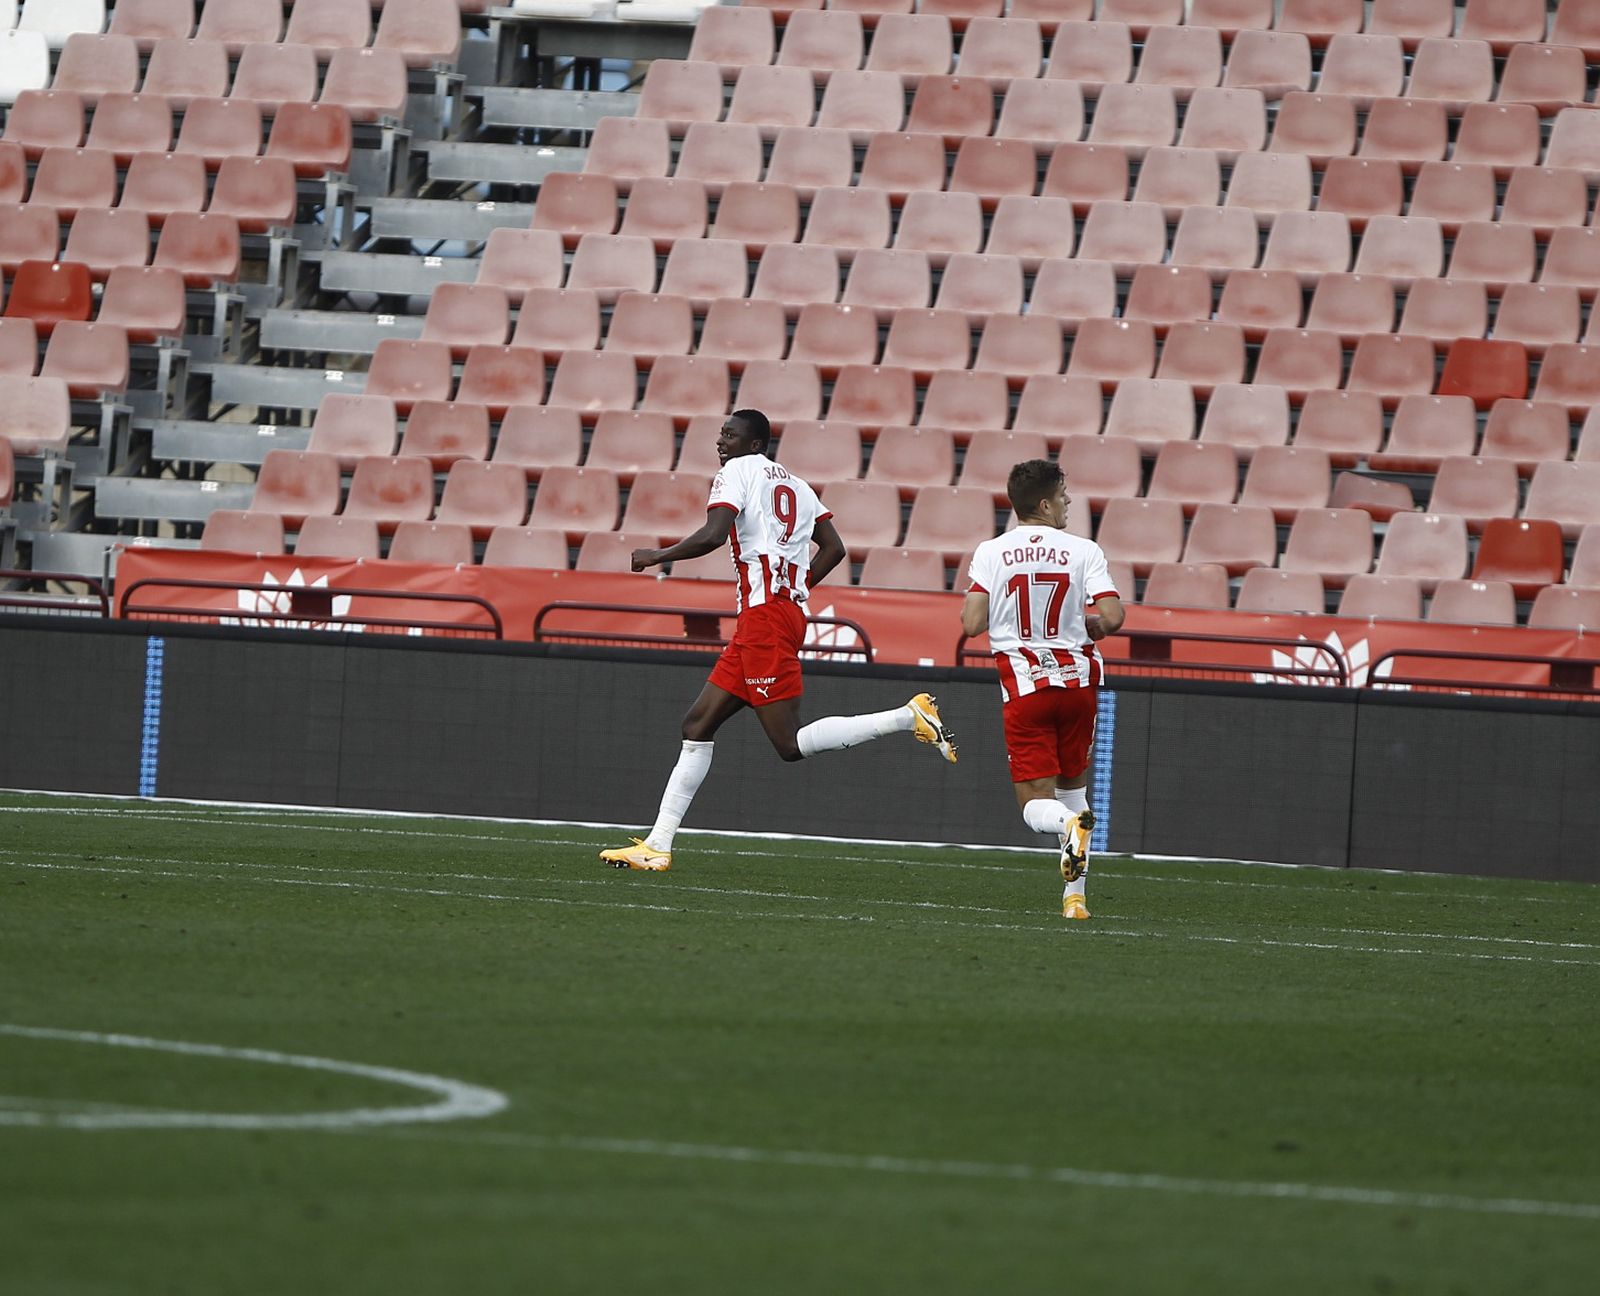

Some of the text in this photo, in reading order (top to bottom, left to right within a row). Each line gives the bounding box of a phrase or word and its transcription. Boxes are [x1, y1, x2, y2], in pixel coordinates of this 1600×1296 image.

[772, 484, 797, 545] 9
[1002, 547, 1070, 566] CORPAS
[1005, 572, 1070, 640] 17
